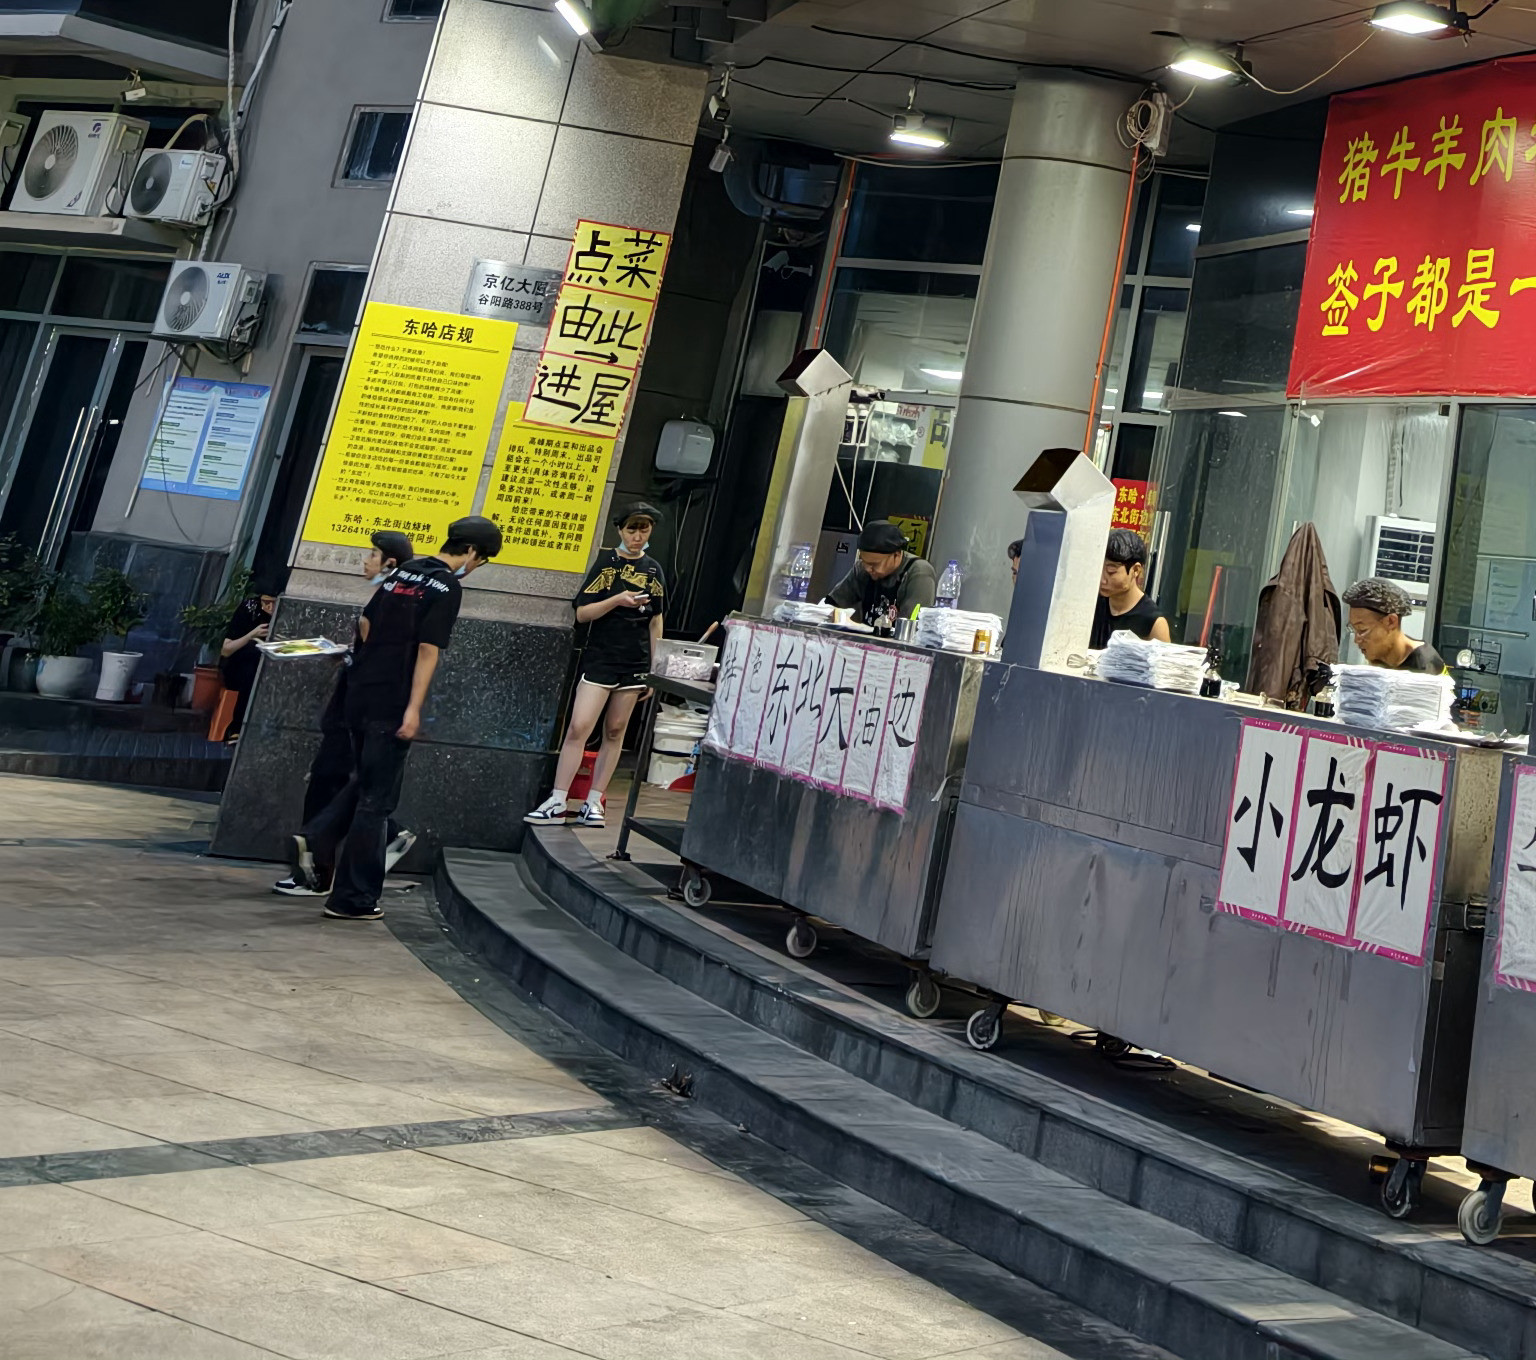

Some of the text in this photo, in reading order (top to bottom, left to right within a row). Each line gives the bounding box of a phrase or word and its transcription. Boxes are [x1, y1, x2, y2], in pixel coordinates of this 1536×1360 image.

[567, 230, 663, 289] 点菜
[402, 318, 475, 344] 东哈店规
[478, 293, 543, 314] 谷阳路388号
[559, 293, 643, 352] 由此
[532, 363, 632, 429] 进屋
[1234, 751, 1444, 911] 小龙虾
